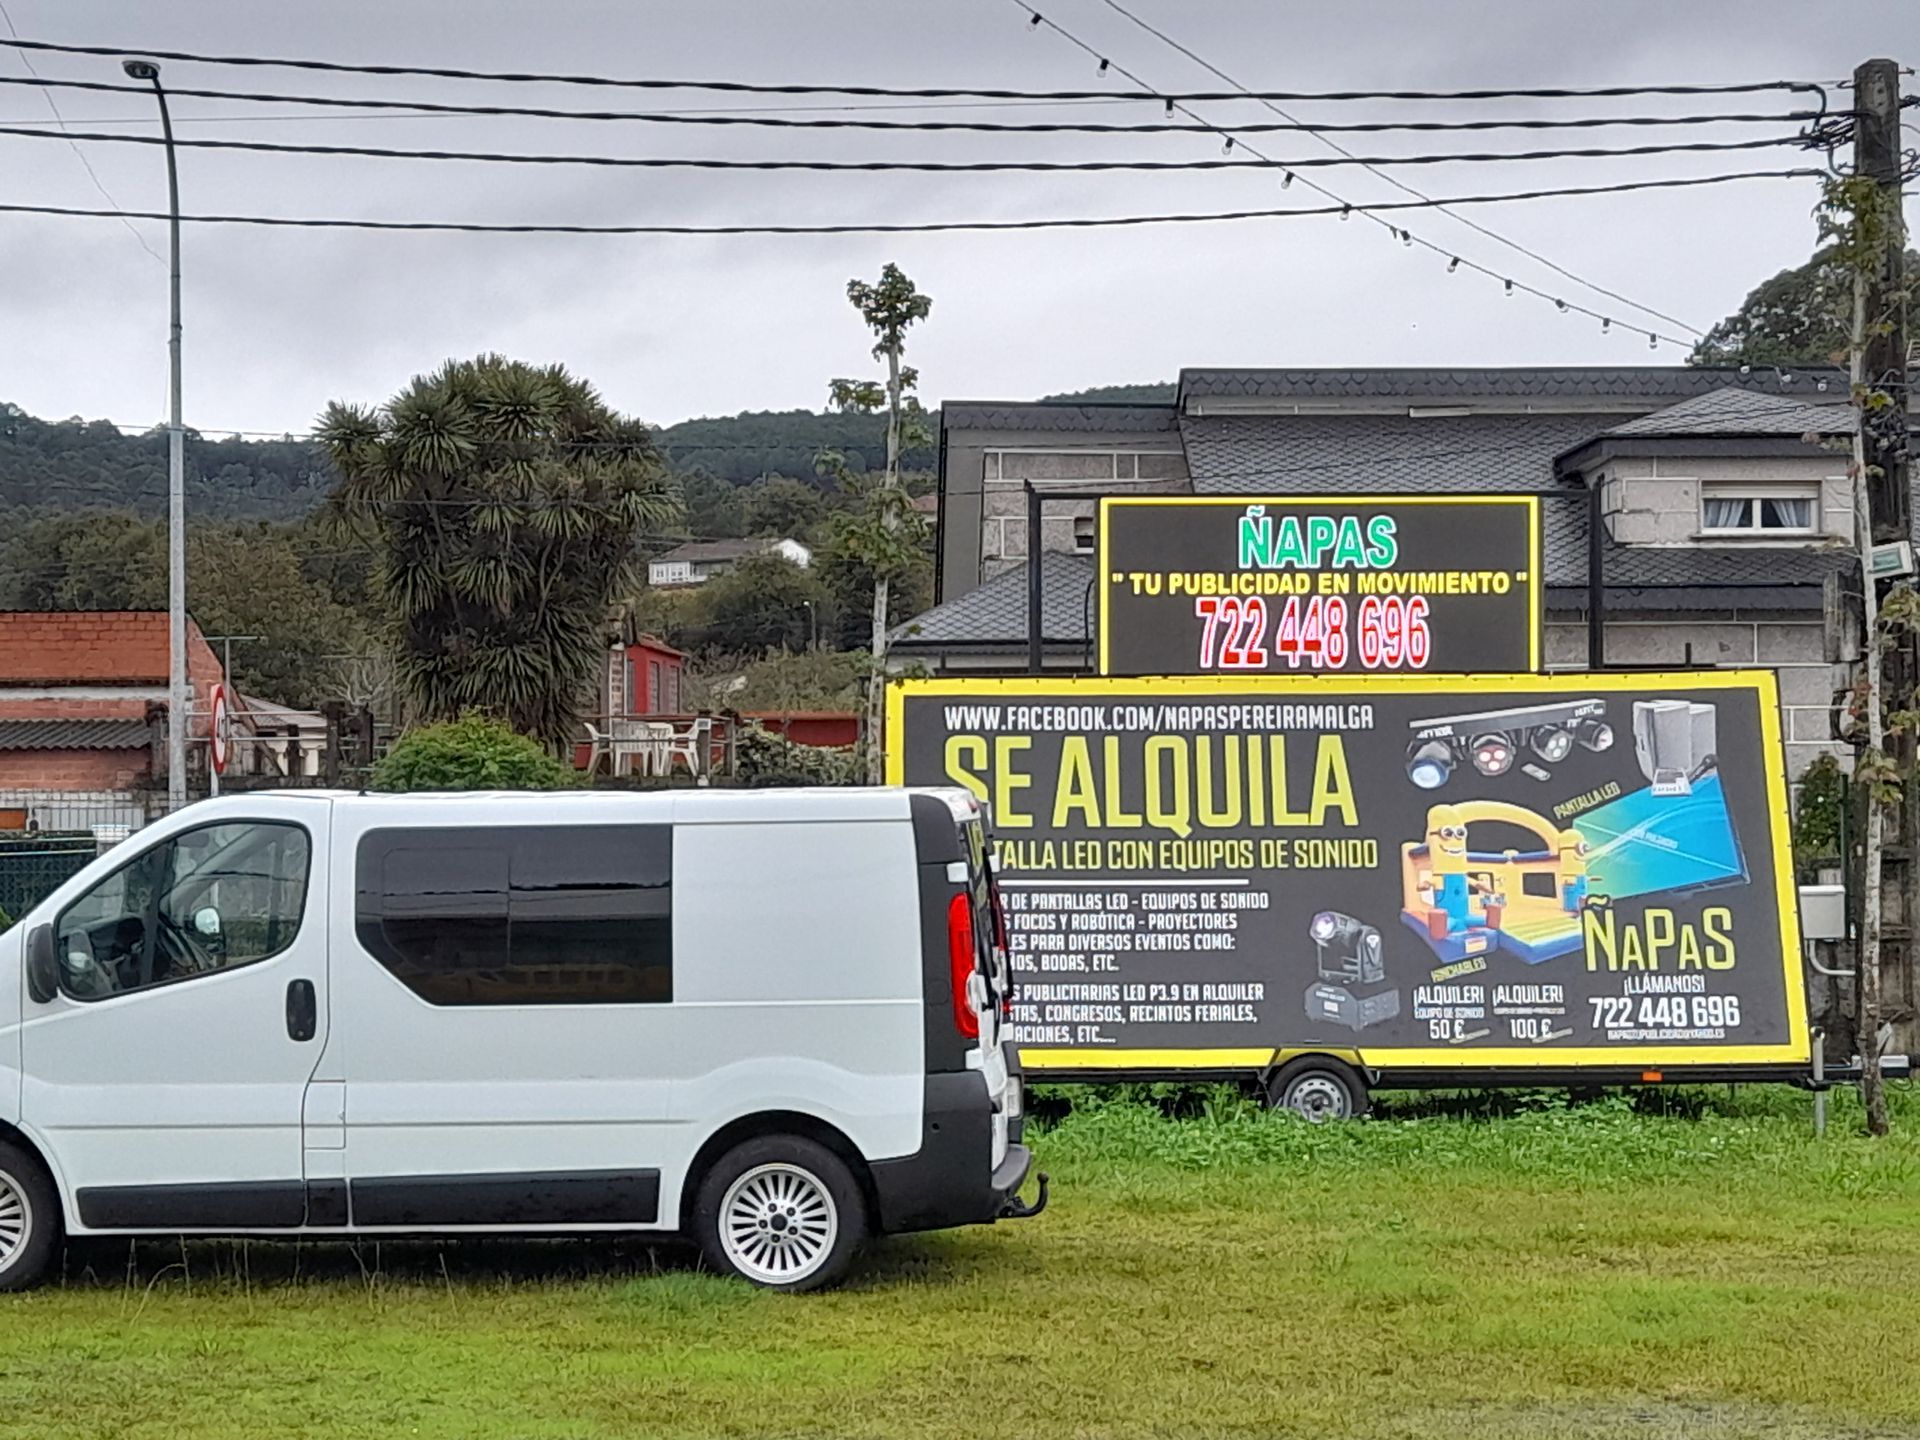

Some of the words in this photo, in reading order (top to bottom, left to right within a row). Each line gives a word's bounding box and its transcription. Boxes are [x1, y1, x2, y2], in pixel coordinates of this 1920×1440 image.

[1239, 505, 1397, 568] ÑAPAS
[1129, 573, 1161, 595] TU
[1169, 573, 1310, 595] PUBLICIDAD
[1317, 573, 1349, 595] EN
[1358, 572, 1509, 596] MOVIMIENTO
[1196, 596, 1267, 668] 722
[1276, 595, 1348, 668] 448
[1358, 595, 1430, 668] 696
[945, 705, 1373, 731] WWW.FACEBOOK.COM/NAPASPEREIRAMALGA
[944, 734, 1034, 828] SE
[1052, 735, 1358, 838] ALQUILA
[1553, 789, 1603, 819] PANTALLA
[1063, 841, 1101, 869] LED
[1108, 841, 1153, 869] CON
[1160, 837, 1253, 871] EQUIPOS
[1261, 840, 1288, 868] DE
[1294, 840, 1377, 868] SONIDO
[1012, 894, 1027, 910] DE
[1031, 894, 1102, 909] PANTALLAS
[1106, 893, 1128, 909] LED
[1142, 893, 1197, 909] EQUIPOS
[1201, 893, 1216, 909] DE
[1221, 893, 1268, 909] SONIDO
[1015, 914, 1056, 930] FOCOS
[1060, 914, 1068, 930] Y
[1072, 911, 1134, 930] ROBÓTICA
[1149, 913, 1237, 930] PROYECTORES
[1031, 934, 1065, 950] PARA
[1069, 934, 1131, 950] DIVERSOS
[1135, 934, 1190, 950] EVENTOS
[1194, 934, 1235, 950] COMO:
[1042, 954, 1089, 972] BODAS,
[1024, 985, 1119, 1001] PUBLICITARIAS
[1124, 985, 1145, 1001] LED
[1150, 984, 1179, 1000] P3.9
[1183, 984, 1199, 1001] EN
[1203, 984, 1263, 1000] ALQUILER
[1046, 1005, 1126, 1023] CONGRESOS,
[1130, 1005, 1191, 1021] RECINTOS
[1195, 1005, 1257, 1022] FERIALES,
[1589, 998, 1634, 1028] 722
[1639, 997, 1687, 1027] 448
[1692, 996, 1740, 1026] 696
[1430, 1019, 1450, 1040] 50
[1511, 1019, 1538, 1041] 100
